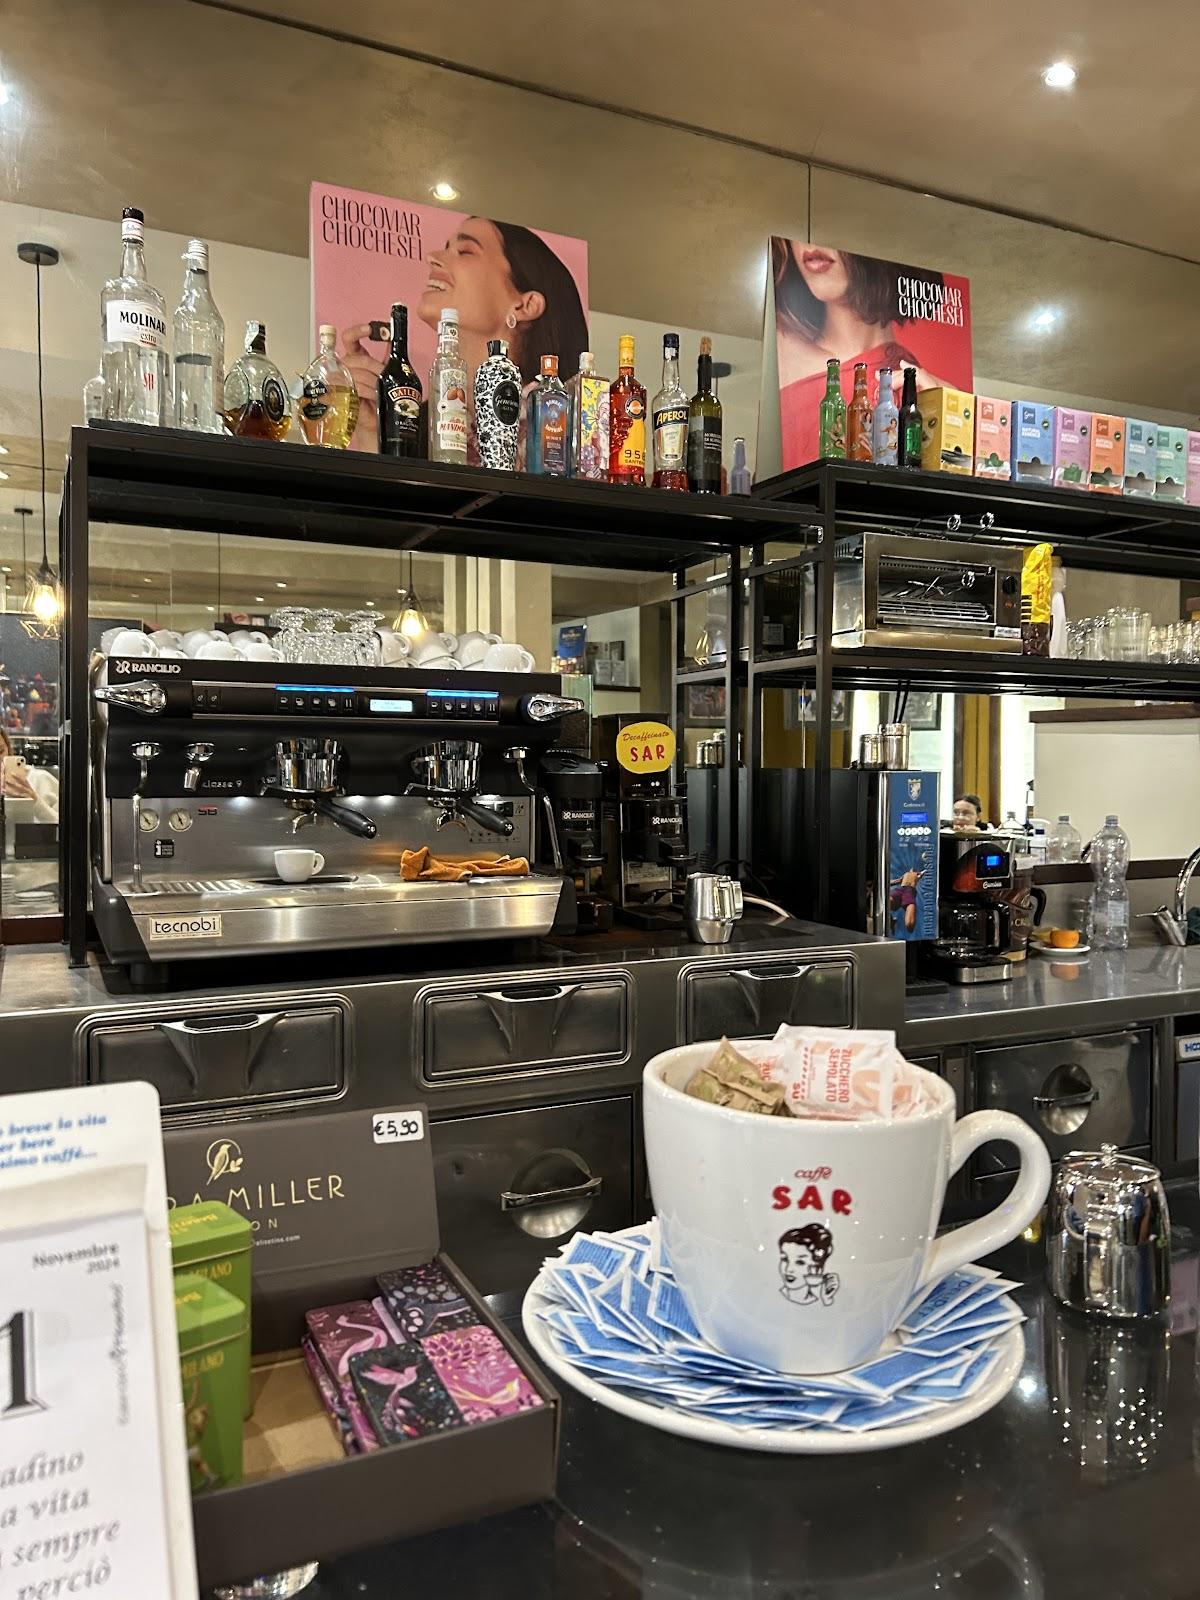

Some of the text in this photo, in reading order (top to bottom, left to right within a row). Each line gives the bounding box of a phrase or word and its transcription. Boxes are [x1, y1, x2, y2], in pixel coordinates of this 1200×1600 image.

[322, 195, 421, 237] CHOCOVIAR
[898, 276, 962, 308] CHOCOVIAR
[656, 411, 687, 426] APEROL
[131, 663, 181, 674] RANCILIO
[630, 744, 665, 762] SAR
[155, 917, 216, 934] tecnobi
[825, 1048, 840, 1103] SEMOLATO
[838, 1048, 852, 1104] ZUCCHERO
[78, 1113, 107, 1127] vita
[227, 1174, 345, 1211] MILLER
[772, 1185, 852, 1216] SAR
[32, 1243, 120, 1269] Novembre
[28, 1488, 90, 1520] vita
[11, 1519, 121, 1567] sempre
